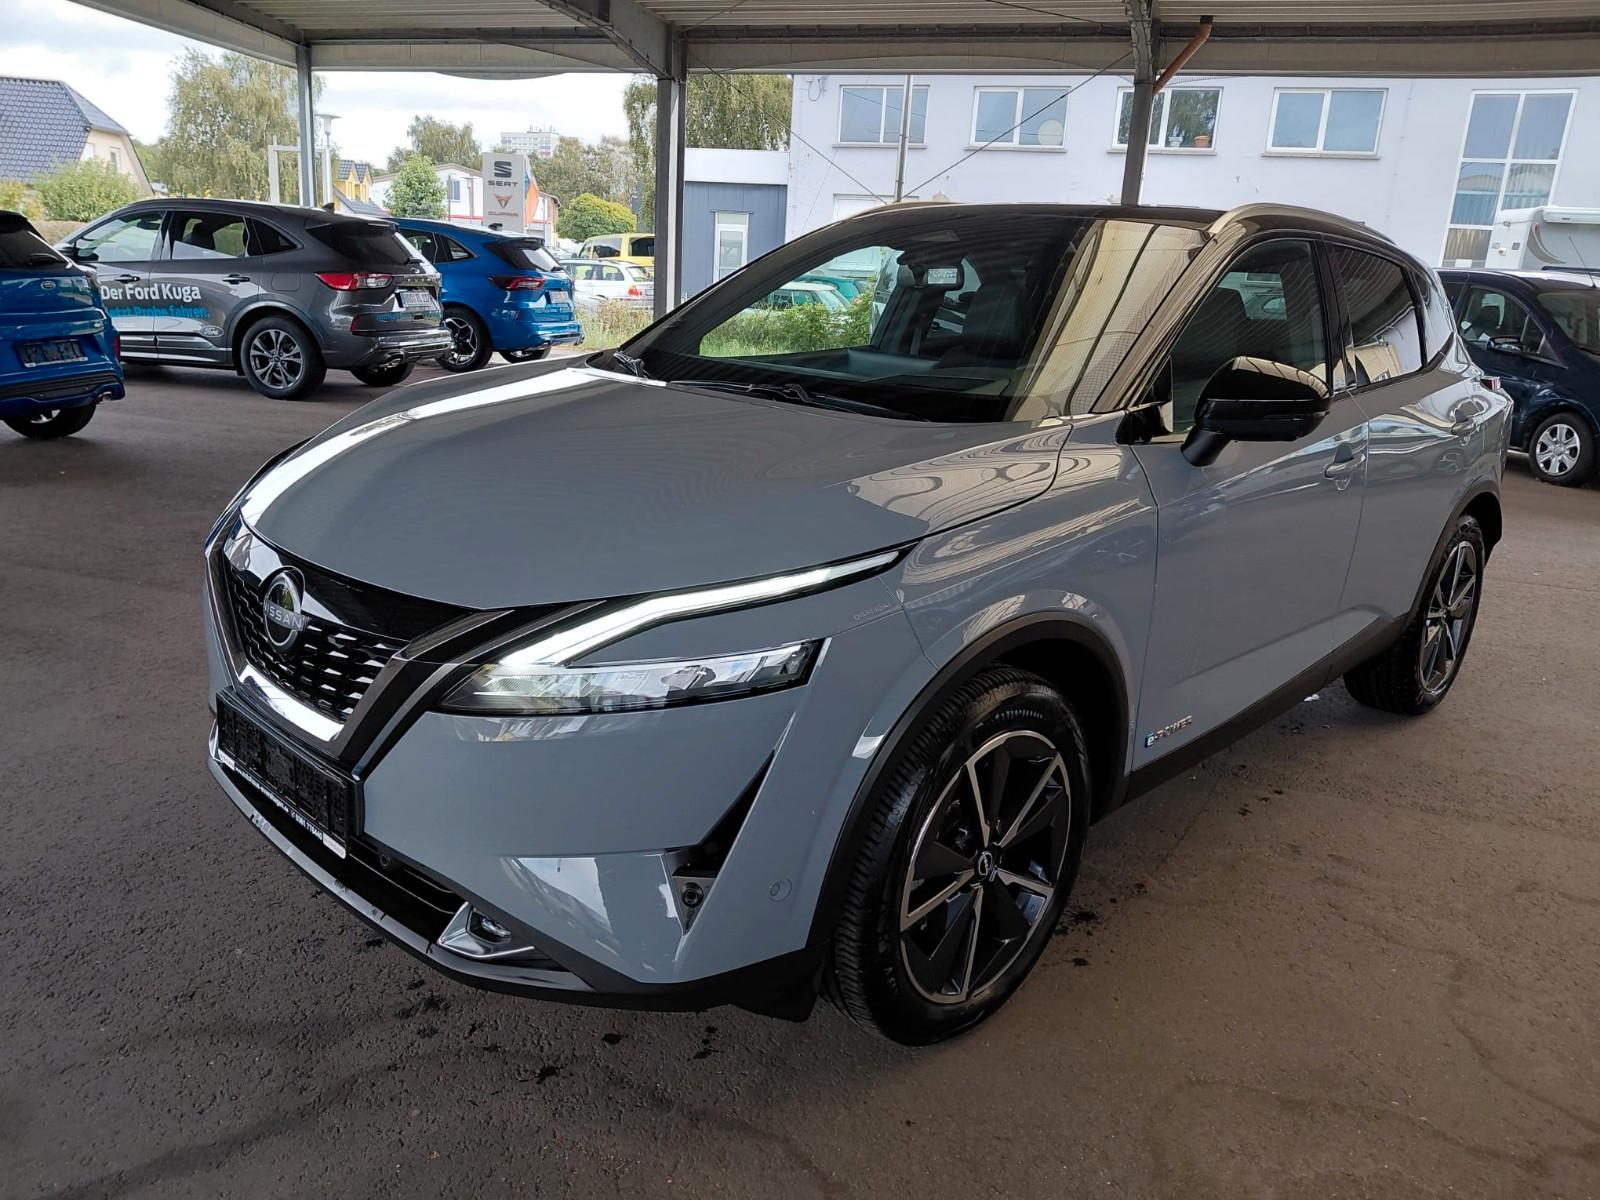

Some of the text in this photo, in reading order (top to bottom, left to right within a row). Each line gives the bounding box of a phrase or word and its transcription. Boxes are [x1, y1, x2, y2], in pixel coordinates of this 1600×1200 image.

[100, 283, 201, 302] Der Ford Kuga
[134, 305, 168, 317] Probe
